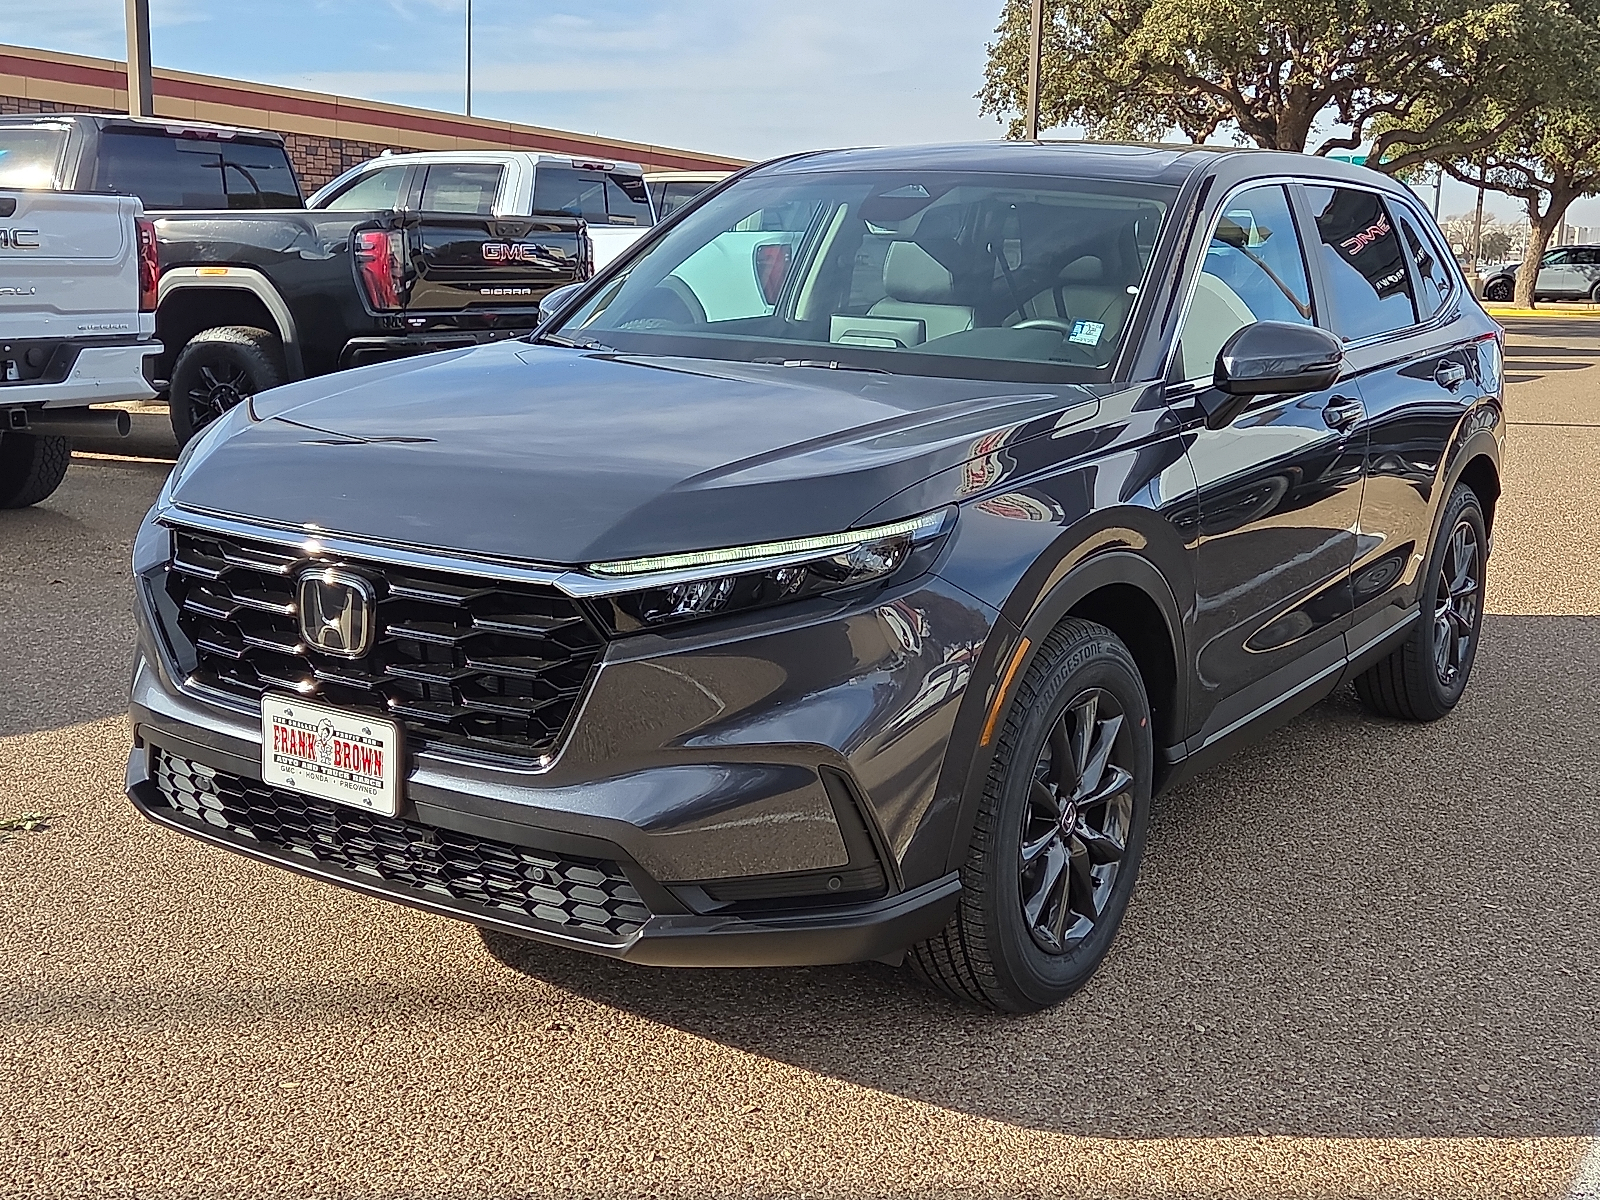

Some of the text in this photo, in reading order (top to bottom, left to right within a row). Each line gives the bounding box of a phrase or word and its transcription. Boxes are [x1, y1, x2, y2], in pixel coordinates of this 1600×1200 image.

[482, 243, 537, 260] GMC
[273, 724, 383, 778] FRANK BROWN
[276, 755, 382, 788] AUTO AND TRUCK RANCH
[280, 765, 378, 795] GMC HONDA PREOWNED
